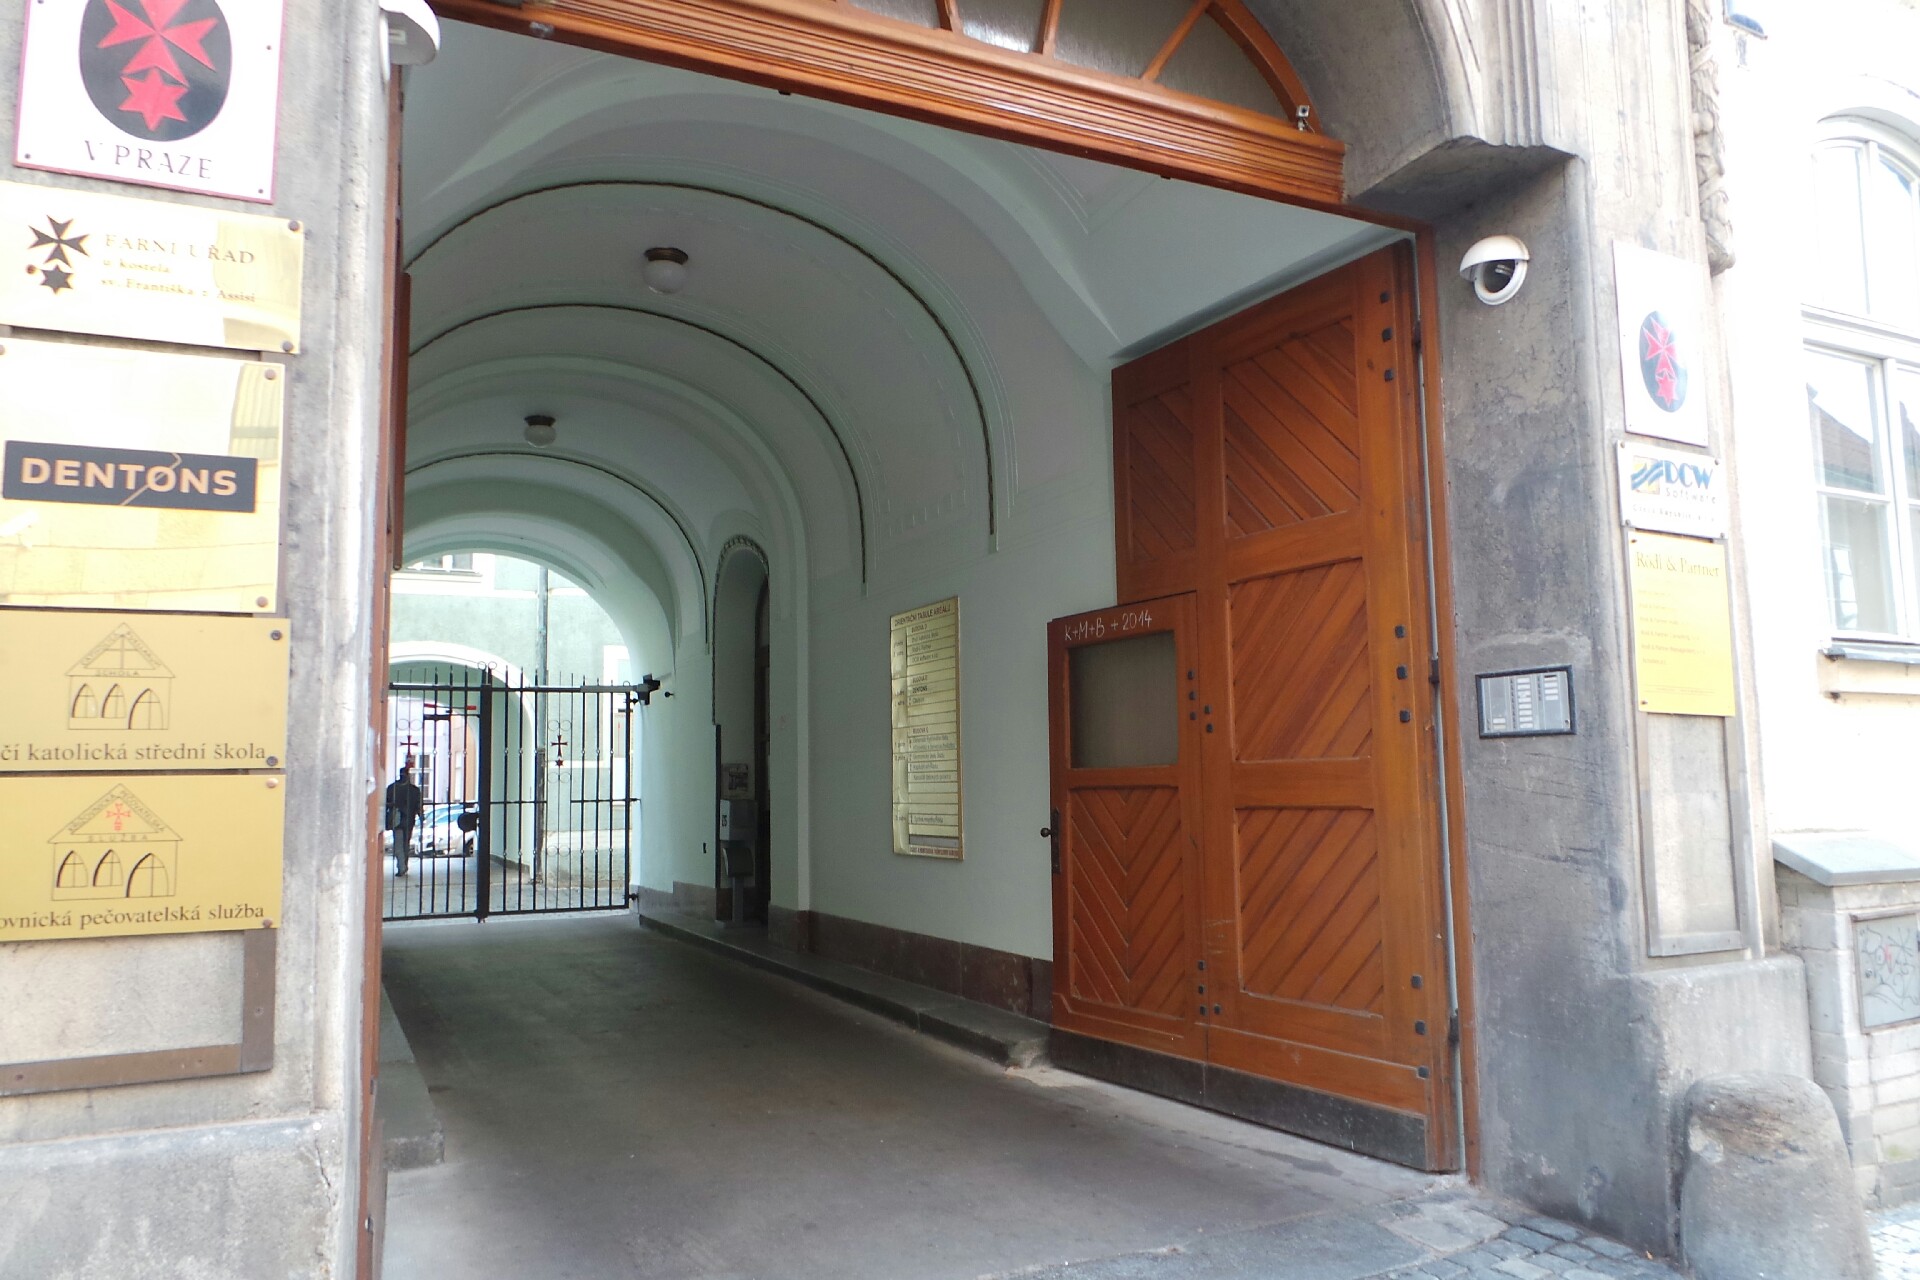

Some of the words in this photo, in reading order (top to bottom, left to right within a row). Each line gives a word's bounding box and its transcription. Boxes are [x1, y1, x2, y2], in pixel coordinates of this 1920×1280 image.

[114, 144, 213, 179] PRAZE
[217, 289, 256, 303] Assisi
[20, 457, 238, 496] DENTONS
[1663, 459, 1714, 490] DCW
[1665, 487, 1717, 505] Software
[1680, 556, 1720, 577] Partner
[1122, 609, 1153, 631] 2014
[0, 743, 20, 761] čí
[28, 742, 128, 761] katolická
[134, 742, 207, 760] střední
[213, 742, 266, 760] škola
[0, 910, 72, 929] ovnická
[79, 905, 202, 930] pečovatelská
[206, 903, 265, 921] služba
